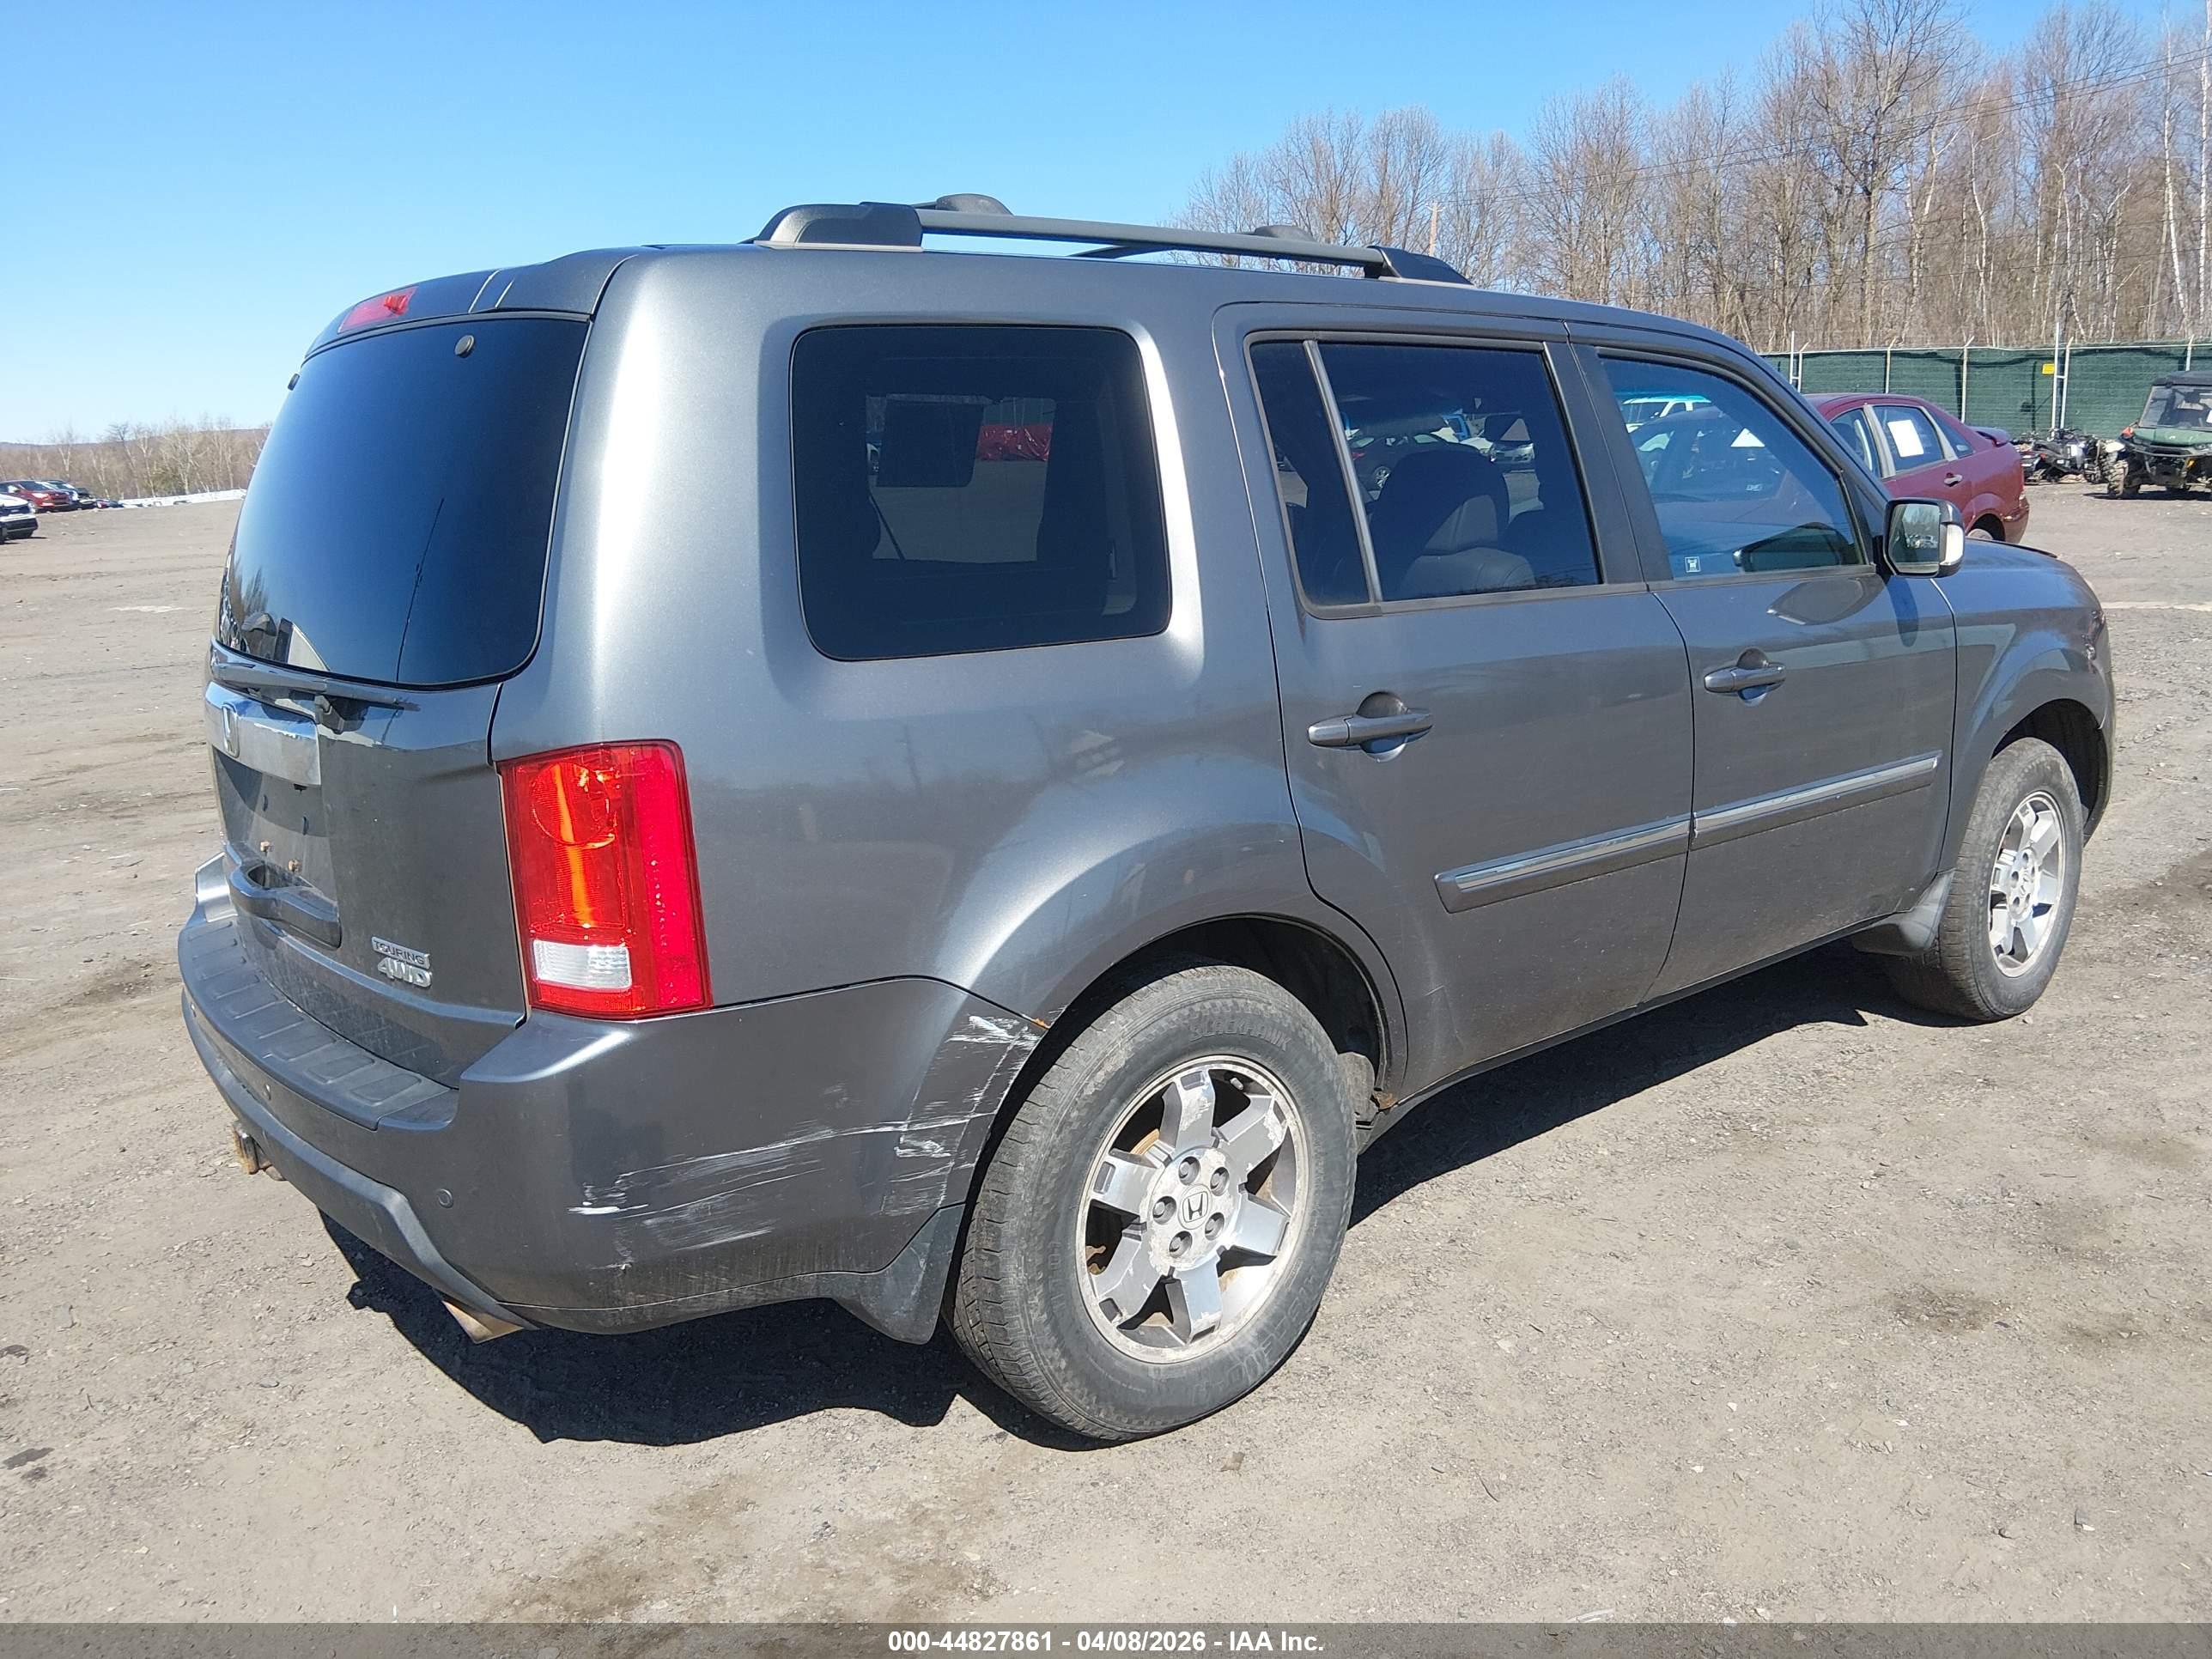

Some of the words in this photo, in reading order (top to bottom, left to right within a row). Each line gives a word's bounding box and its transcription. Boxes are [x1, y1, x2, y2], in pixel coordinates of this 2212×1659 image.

[372, 938, 428, 967] TOURING
[378, 957, 431, 988] 4WD
[1188, 1193, 1203, 1220] H
